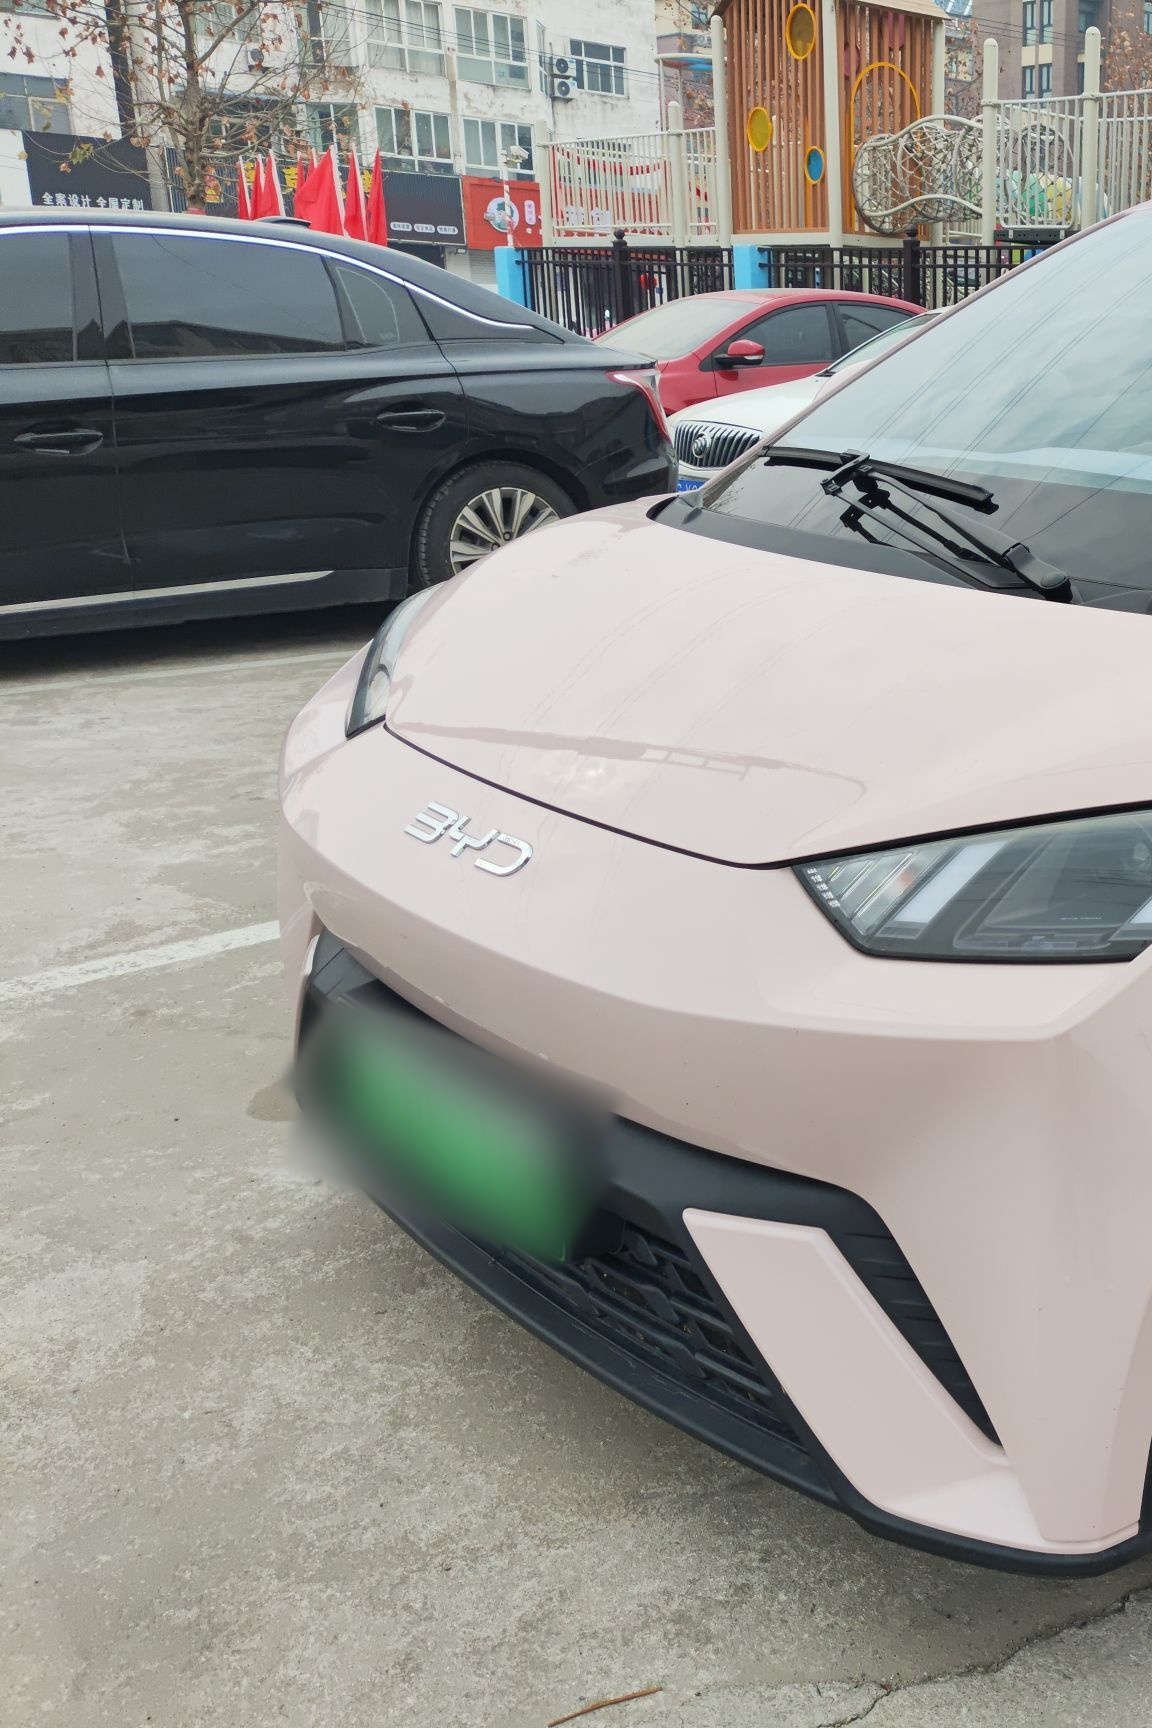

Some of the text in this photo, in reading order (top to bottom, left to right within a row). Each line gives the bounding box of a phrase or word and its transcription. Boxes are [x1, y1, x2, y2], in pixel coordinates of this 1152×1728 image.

[42, 192, 144, 211] 全案设计 全屋定制
[404, 801, 533, 877] BYD
